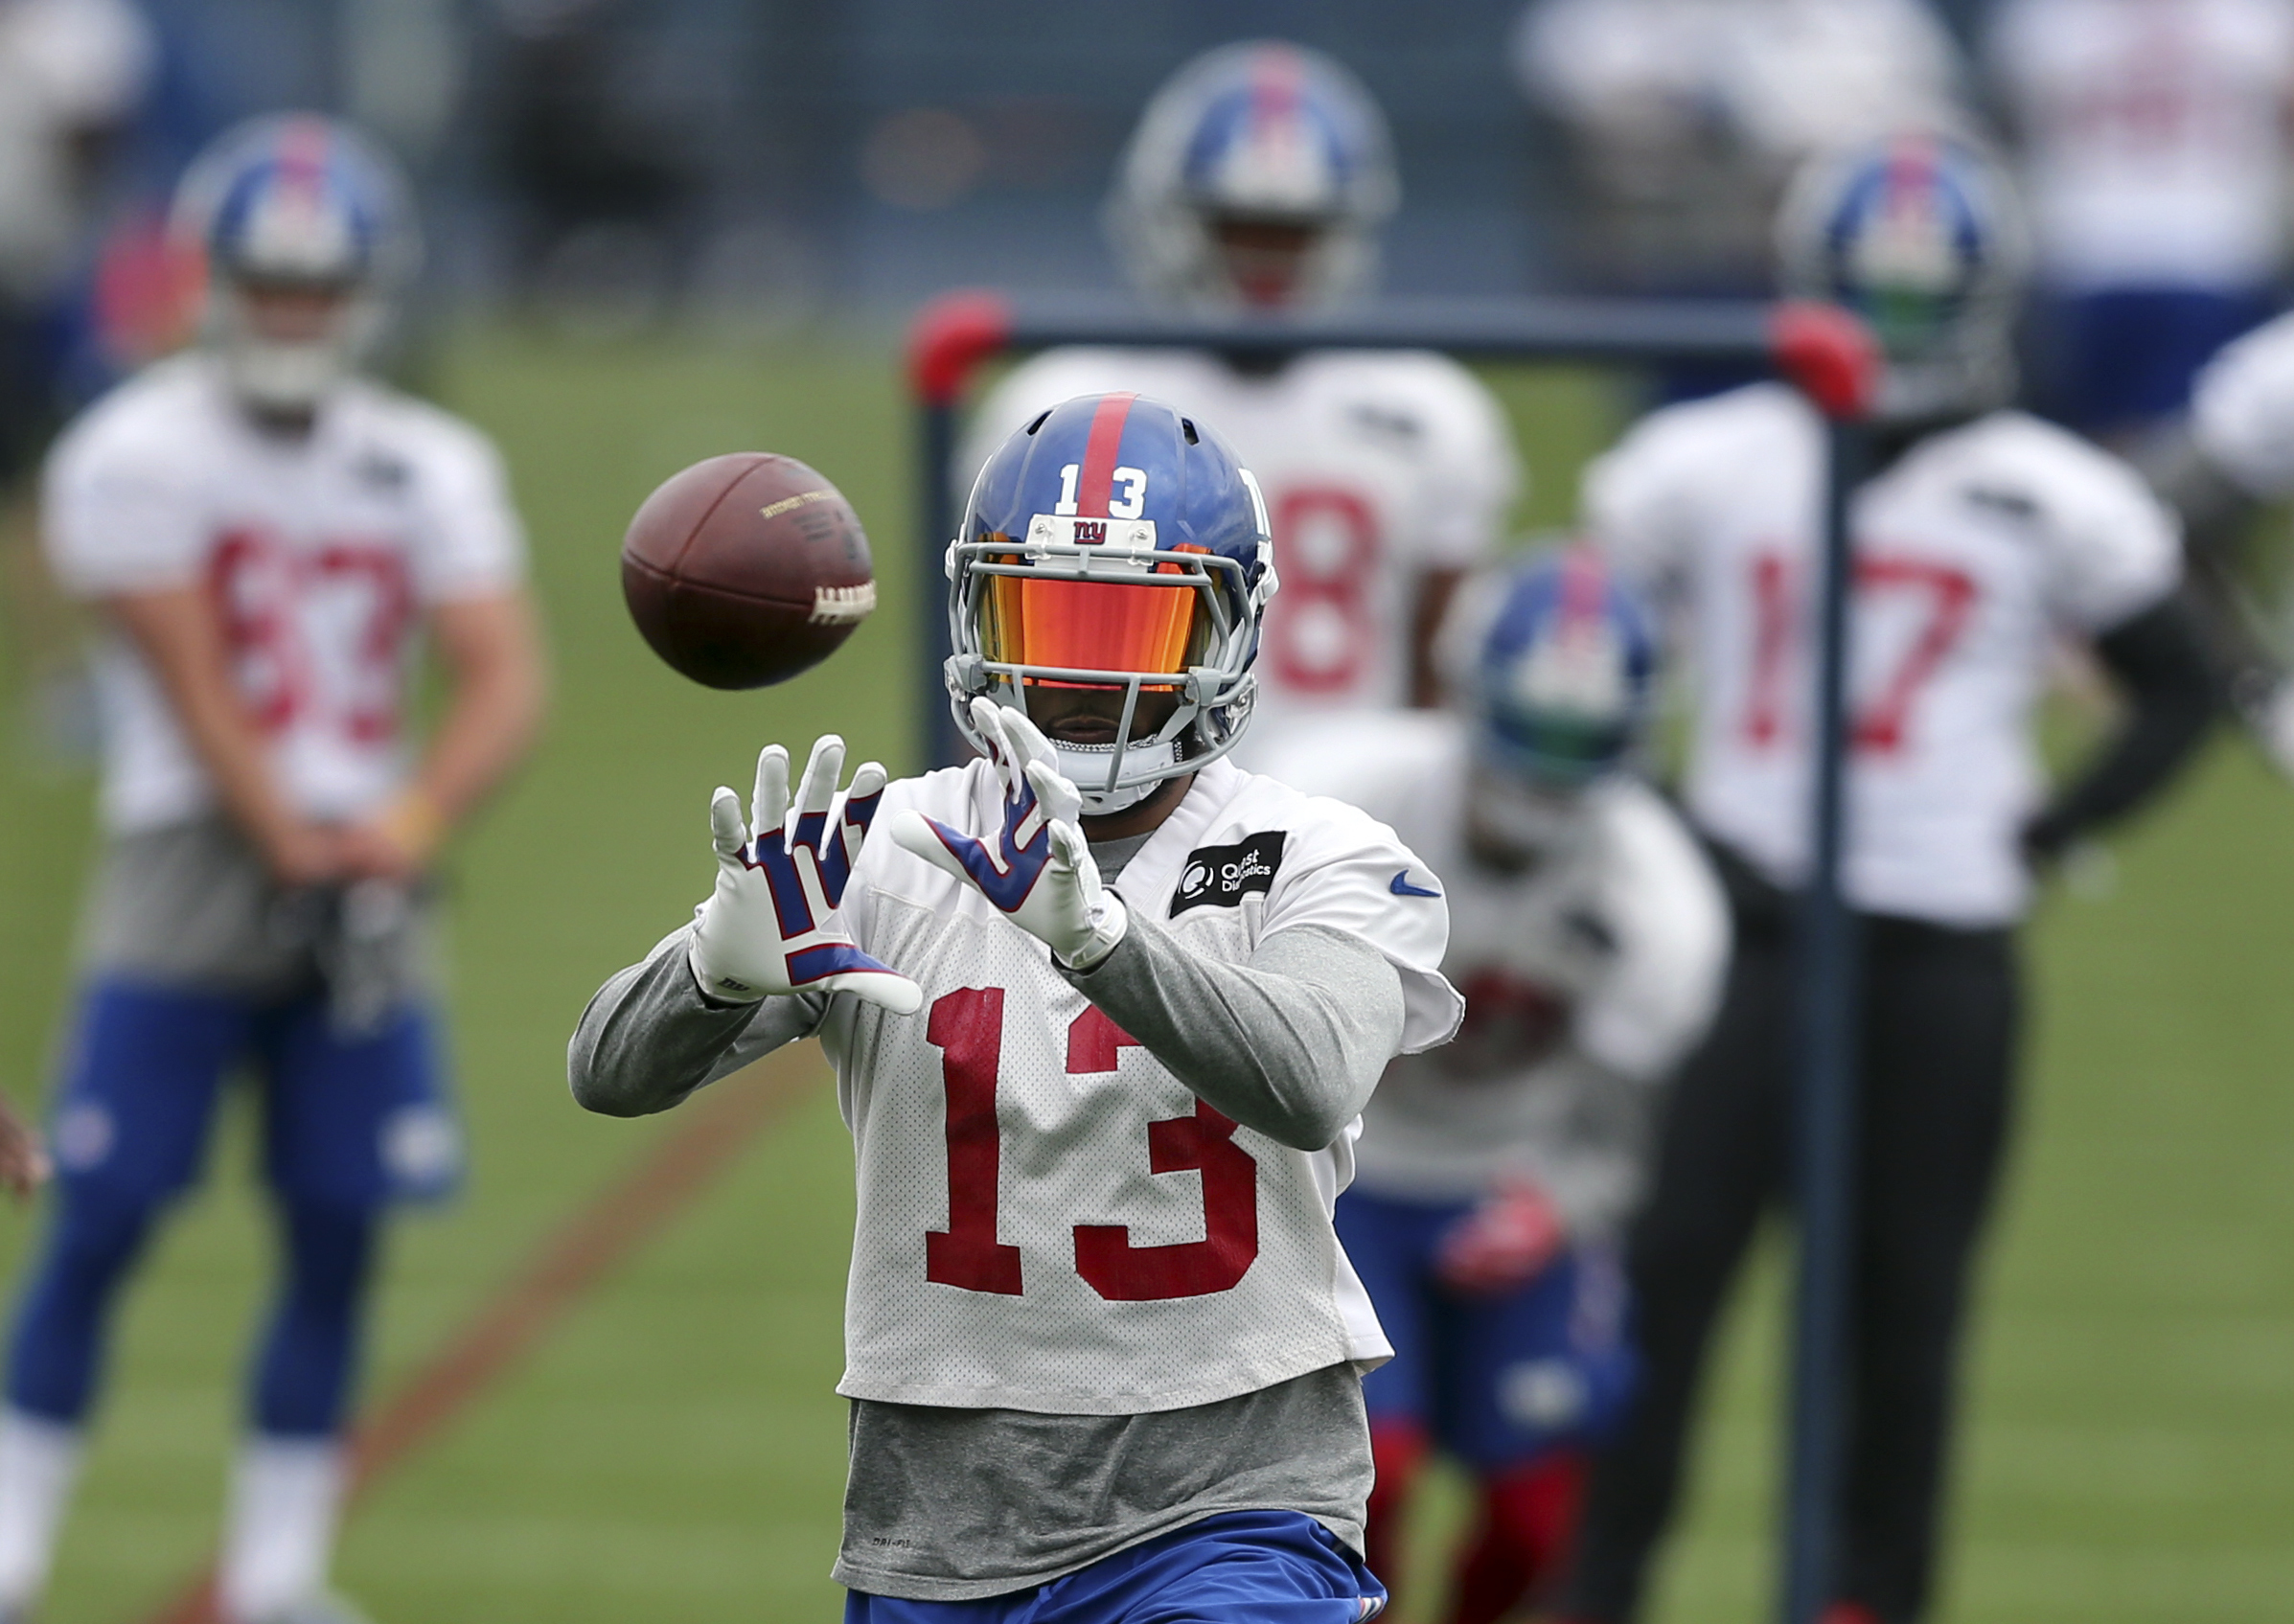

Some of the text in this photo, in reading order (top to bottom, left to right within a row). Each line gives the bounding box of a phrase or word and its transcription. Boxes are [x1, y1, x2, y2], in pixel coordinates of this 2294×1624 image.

[1055, 464, 1148, 520] 13
[1746, 551, 1980, 762] 17
[926, 986, 1258, 1301] 13
